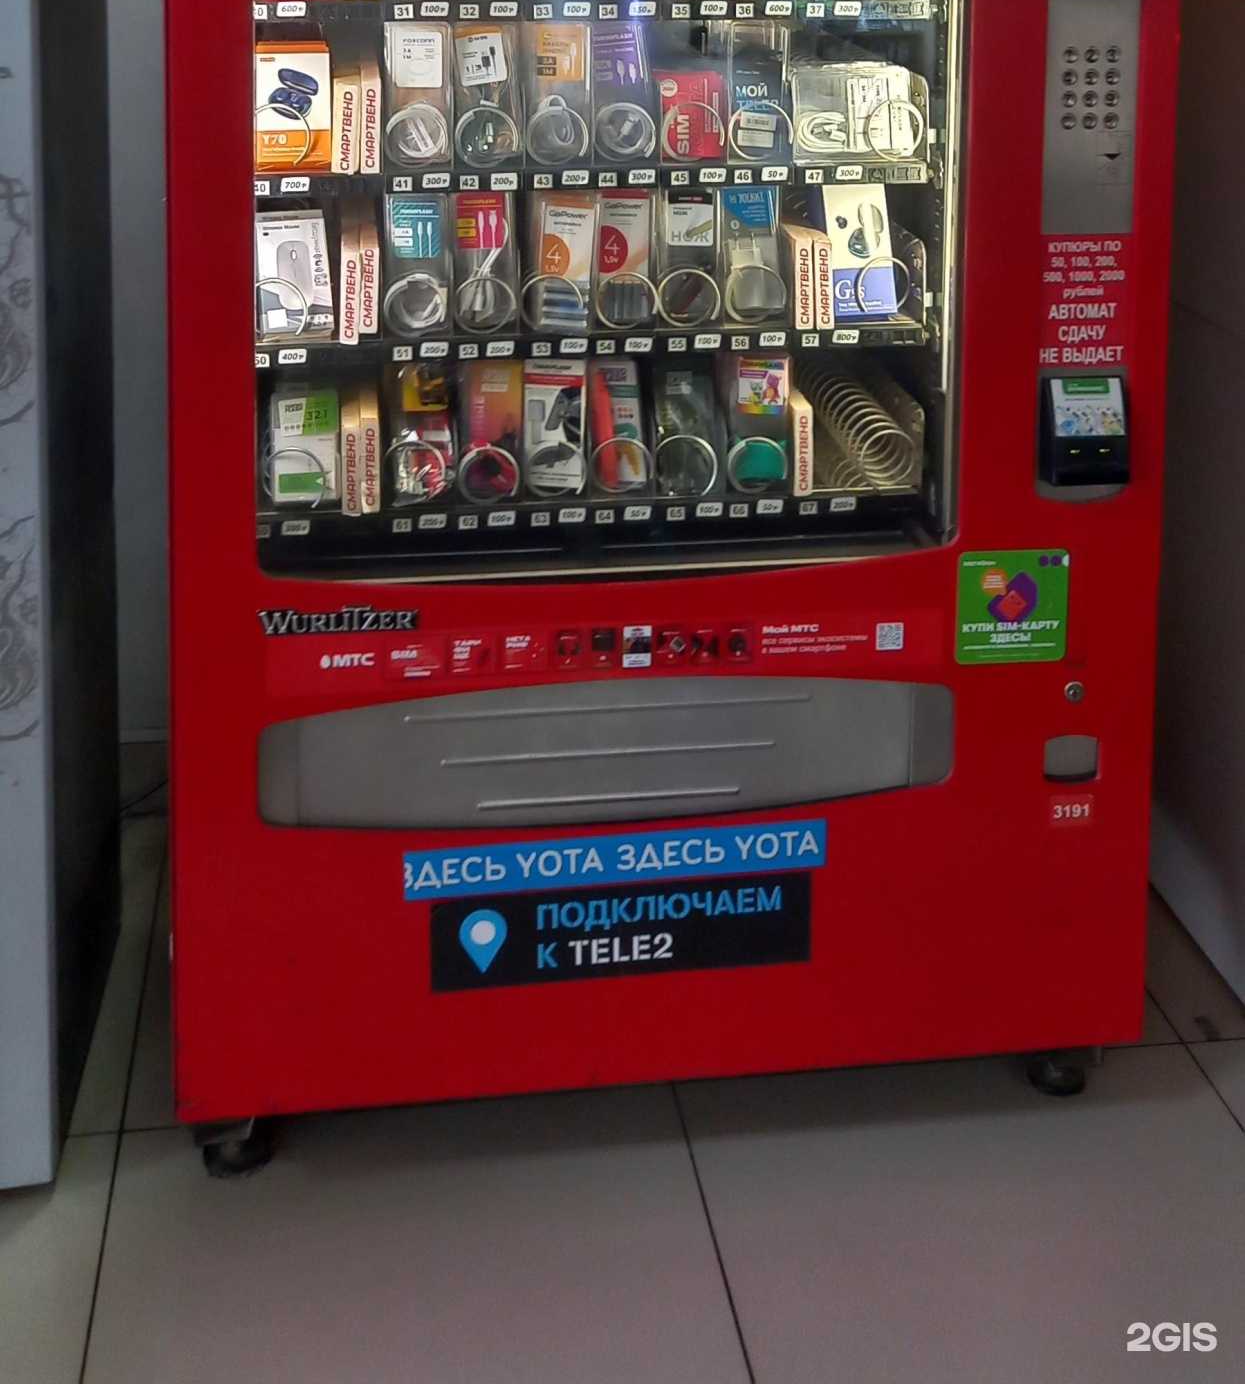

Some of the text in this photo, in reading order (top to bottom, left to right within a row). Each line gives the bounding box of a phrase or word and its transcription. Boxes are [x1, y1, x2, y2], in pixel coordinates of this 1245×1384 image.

[397, 7, 409, 16] 31
[463, 6, 476, 16] 32
[601, 6, 615, 16] 34
[674, 6, 687, 15] 35
[738, 5, 751, 15] 36
[809, 5, 822, 14] 37
[736, 83, 768, 97] МОЙ
[263, 134, 287, 144] Y70
[677, 115, 690, 154] SIM
[536, 176, 550, 186] 43
[601, 175, 614, 184] 44
[673, 173, 687, 183] 45
[737, 171, 749, 181] 46
[808, 172, 820, 181] 47
[395, 179, 408, 189] 41
[462, 178, 476, 187] 42
[604, 235, 620, 255] 4
[1048, 241, 1122, 252] КУПЮРЫ ПО
[546, 244, 561, 264] 4
[1063, 285, 1104, 299] рублей
[1048, 303, 1117, 320] АВТОМАТ
[1058, 325, 1106, 343] СДАЧУ
[734, 338, 746, 347] 56
[804, 335, 817, 344] 57
[1040, 347, 1123, 364] НЕ ВЫДАЕТ
[790, 624, 819, 633] МТС
[333, 652, 375, 667] МТС
[1053, 803, 1090, 818] 3191
[516, 848, 604, 879] YOTA
[616, 838, 725, 872] ЗДЕСЬ
[735, 830, 819, 861] YOTA
[536, 885, 782, 932] ПОДКЛЮЧАЕМ
[567, 932, 674, 966] TELE2
